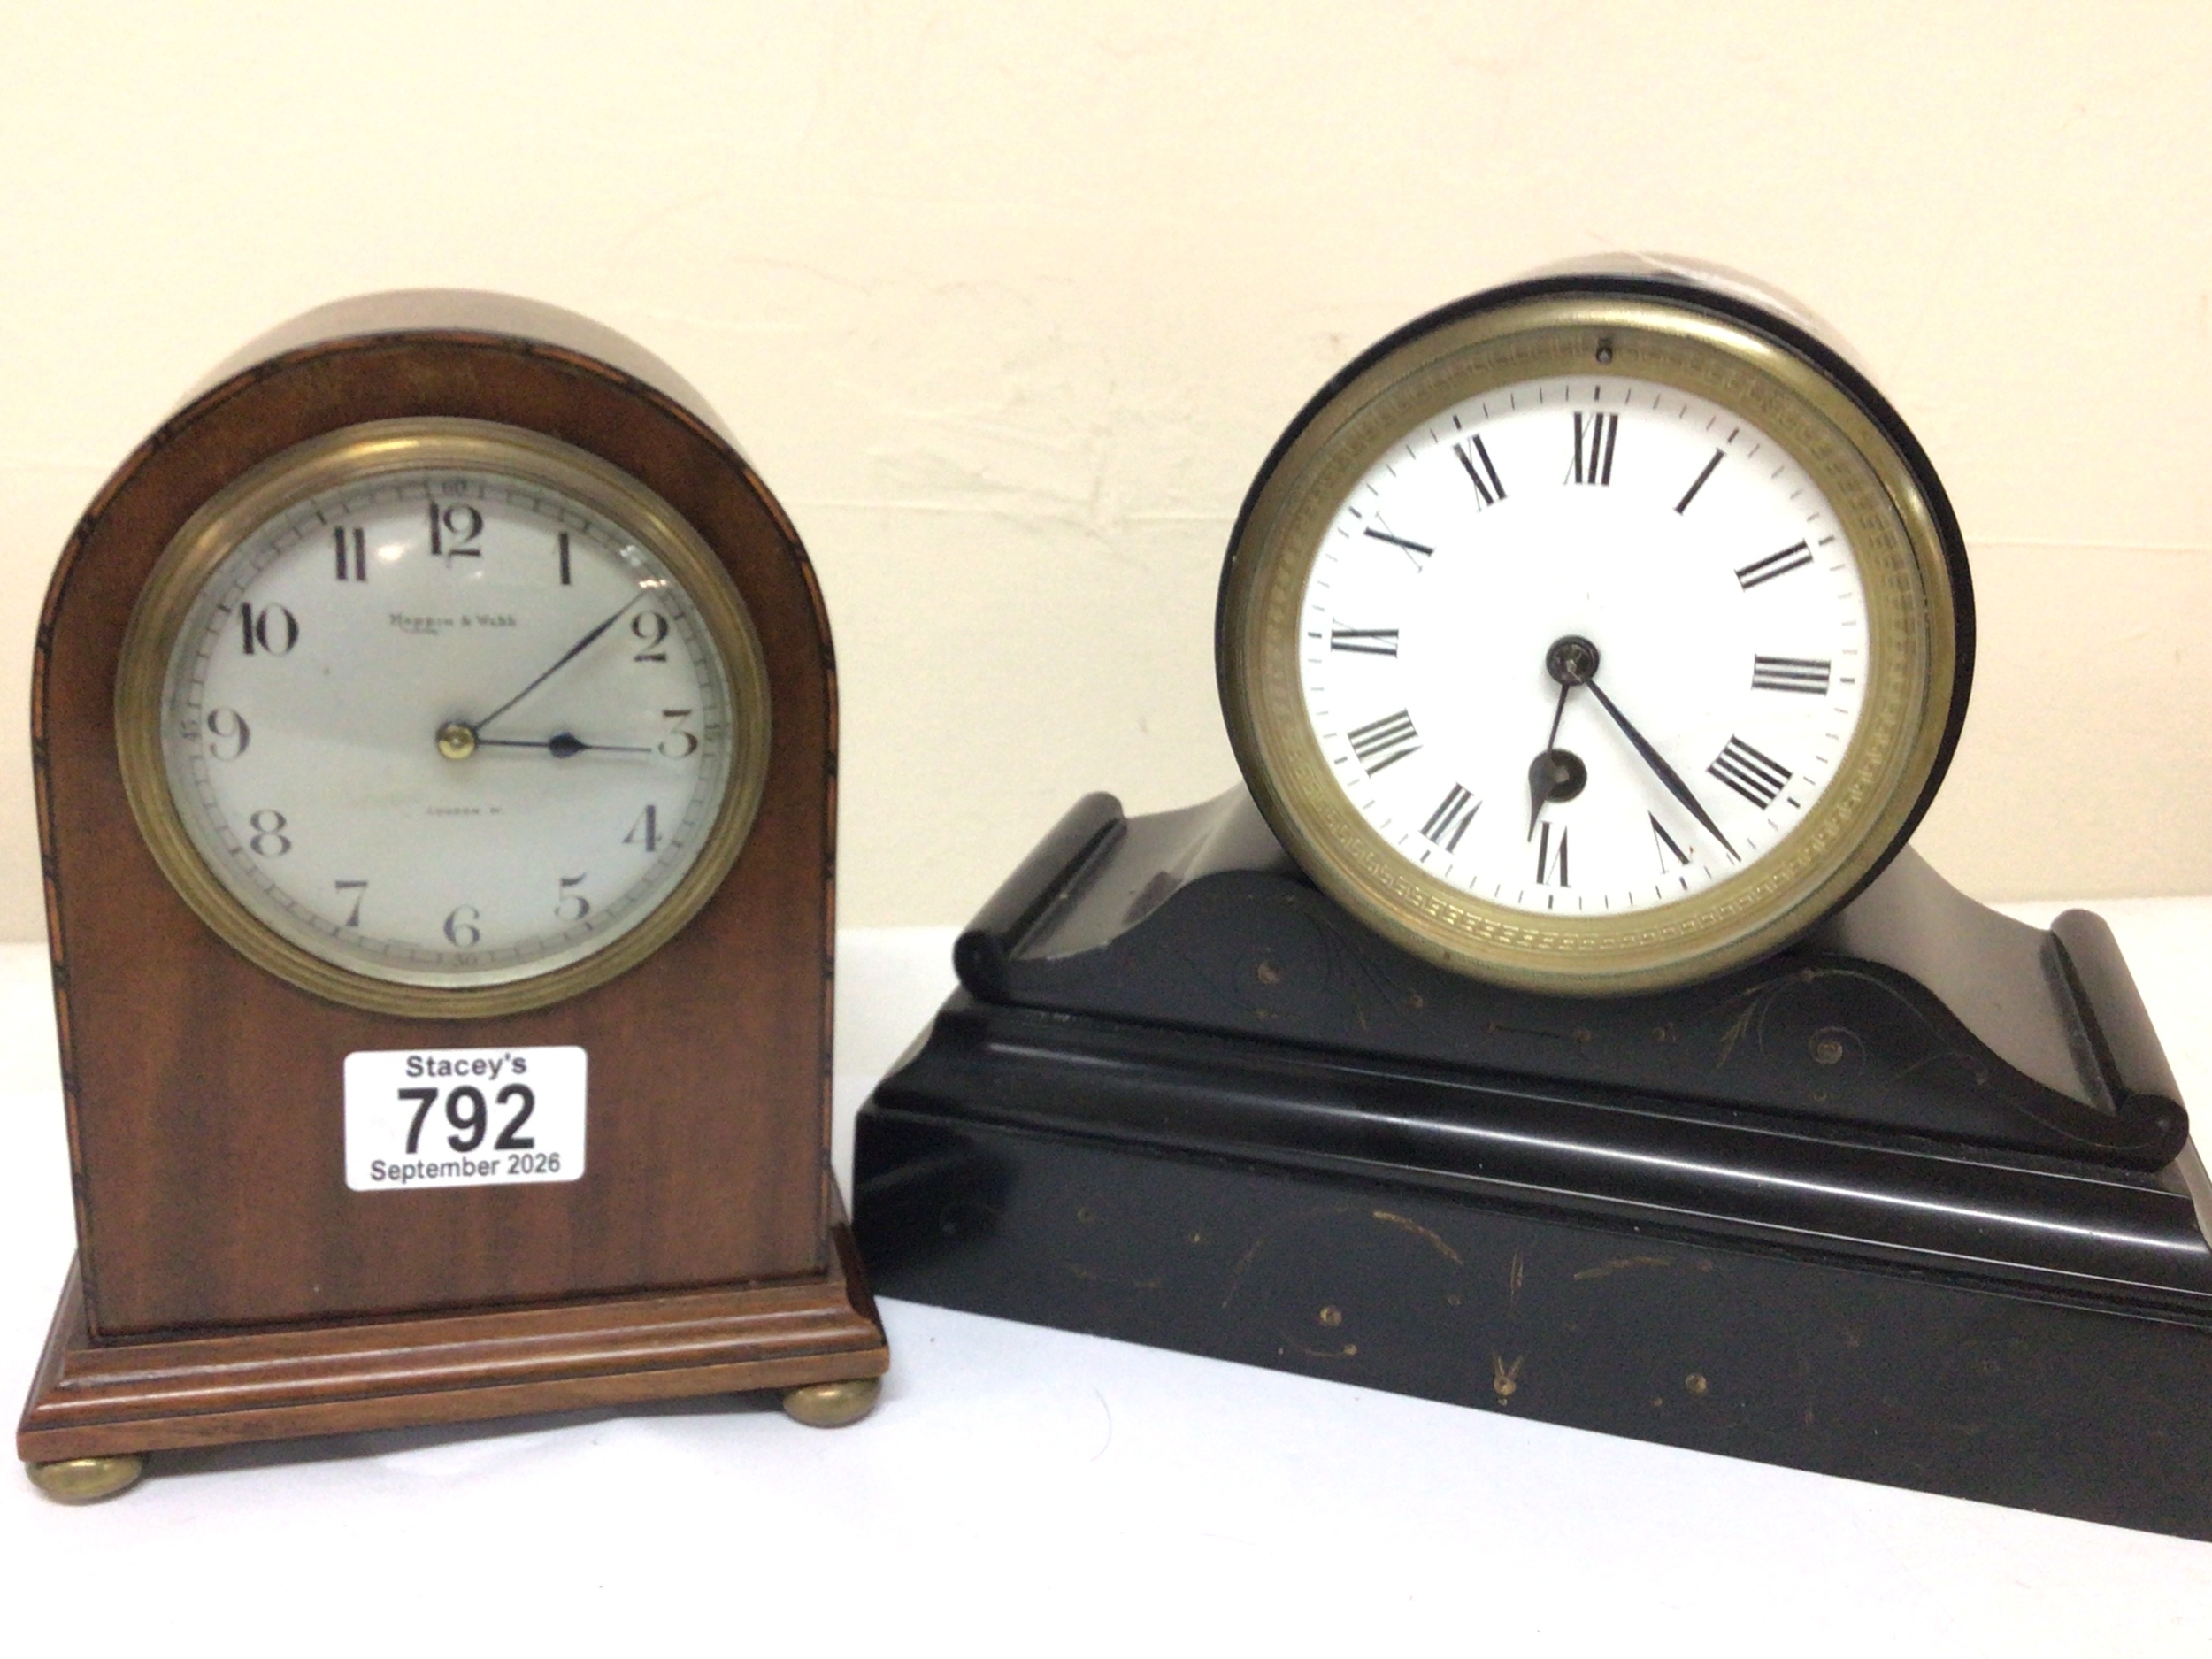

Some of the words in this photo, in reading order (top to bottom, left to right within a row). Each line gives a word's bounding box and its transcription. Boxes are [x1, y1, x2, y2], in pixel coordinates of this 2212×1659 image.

[1453, 434, 1508, 511] XI
[1564, 411, 1619, 487] XII
[1674, 448, 1726, 516] I
[335, 527, 366, 581] 11
[429, 502, 483, 557] 12
[1363, 512, 1435, 572] X
[557, 531, 572, 586] 1
[1735, 539, 1813, 590] II
[241, 601, 300, 657] 10
[630, 611, 670, 663] 2
[1751, 654, 1832, 696] III
[207, 706, 250, 762] 9
[657, 709, 698, 761] 3
[1347, 710, 1422, 777] VIII
[1707, 734, 1794, 810] IIII
[249, 810, 292, 857] 8
[622, 804, 662, 854] 4
[1420, 782, 1482, 854] VII
[1647, 810, 1691, 874] V
[1537, 820, 1571, 888] VI
[334, 880, 368, 928] 7
[444, 903, 480, 948] 6
[555, 873, 591, 923] 5
[405, 1053, 527, 1080] Stacey's
[397, 1083, 535, 1155] 792
[370, 1156, 500, 1184] September
[507, 1153, 561, 1175] 2026
